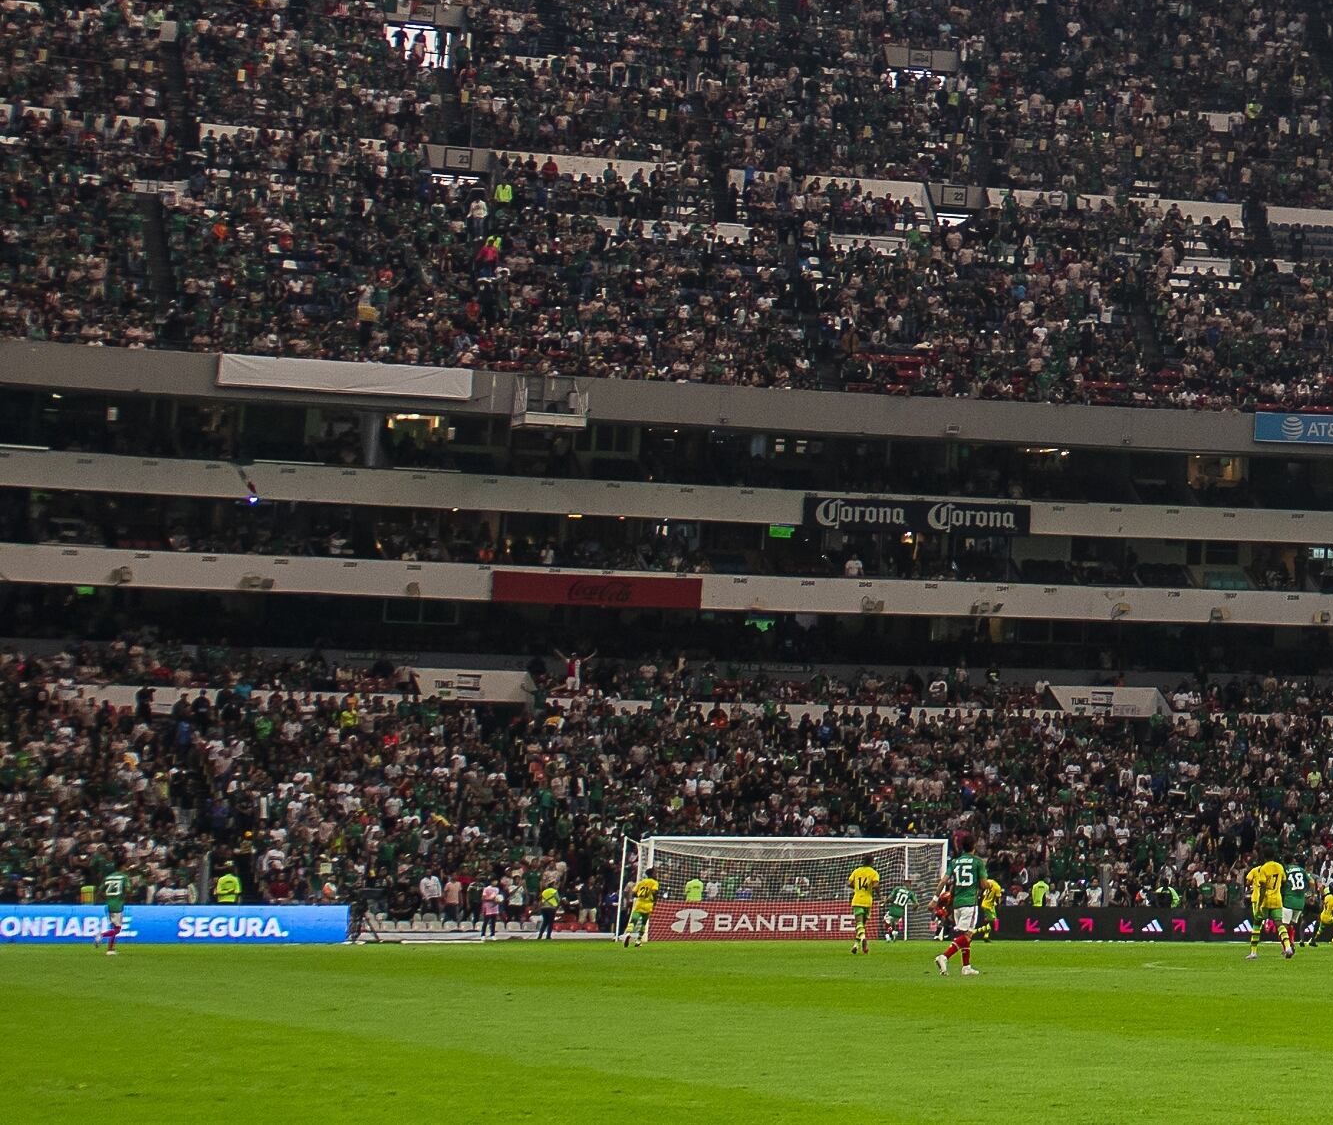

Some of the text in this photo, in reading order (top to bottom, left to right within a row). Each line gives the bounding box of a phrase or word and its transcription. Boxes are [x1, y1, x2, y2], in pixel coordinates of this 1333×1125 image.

[954, 192, 964, 201] 22
[816, 498, 905, 529] Corona
[927, 503, 1016, 533] Corona
[435, 680, 454, 689] TUNEL
[1071, 697, 1090, 706] TUNEL
[954, 865, 974, 886] 15
[1288, 873, 1305, 891] 18
[105, 880, 123, 895] 23
[893, 892, 908, 906] 10
[0, 916, 288, 938] ONFIABLE. SEGURA.
[714, 914, 856, 933] BANORTE
